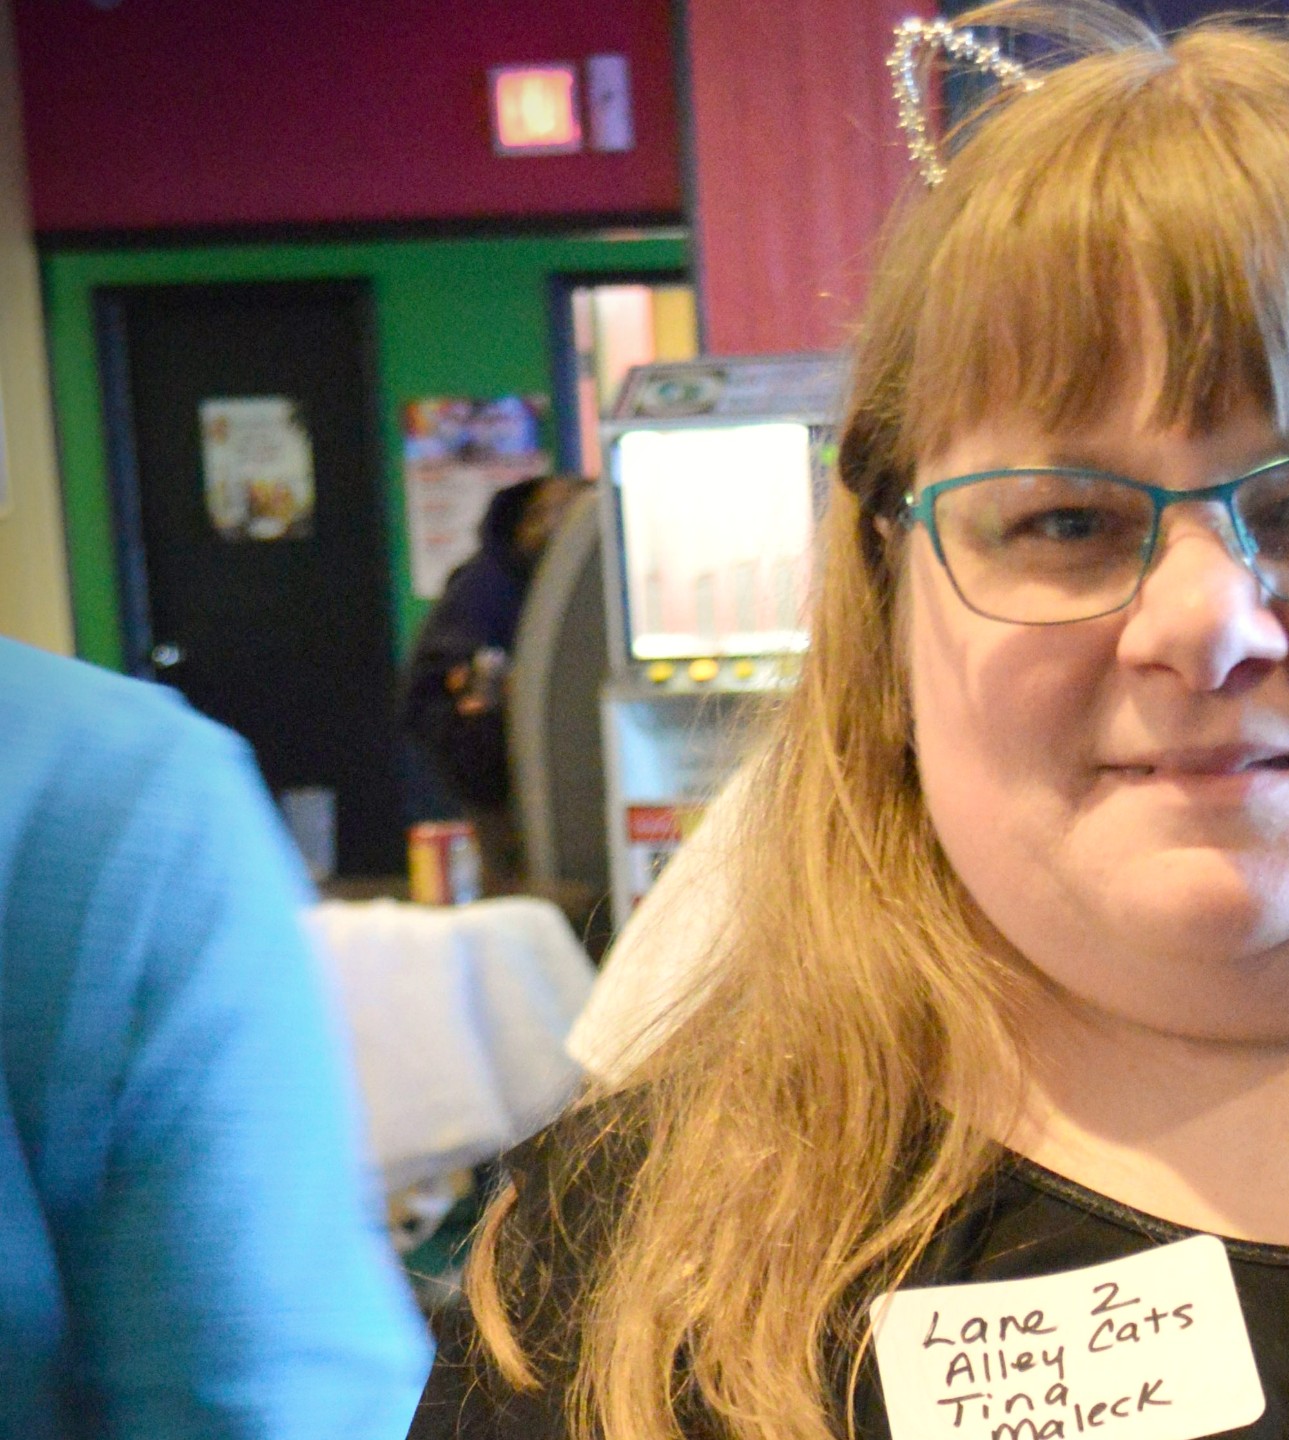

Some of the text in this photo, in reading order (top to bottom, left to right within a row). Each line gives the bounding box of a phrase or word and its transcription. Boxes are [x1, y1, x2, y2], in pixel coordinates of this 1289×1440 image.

[923, 1282, 1141, 1349] Lane 2
[945, 1345, 1065, 1387] Alley
[937, 1381, 1070, 1428] Tina
